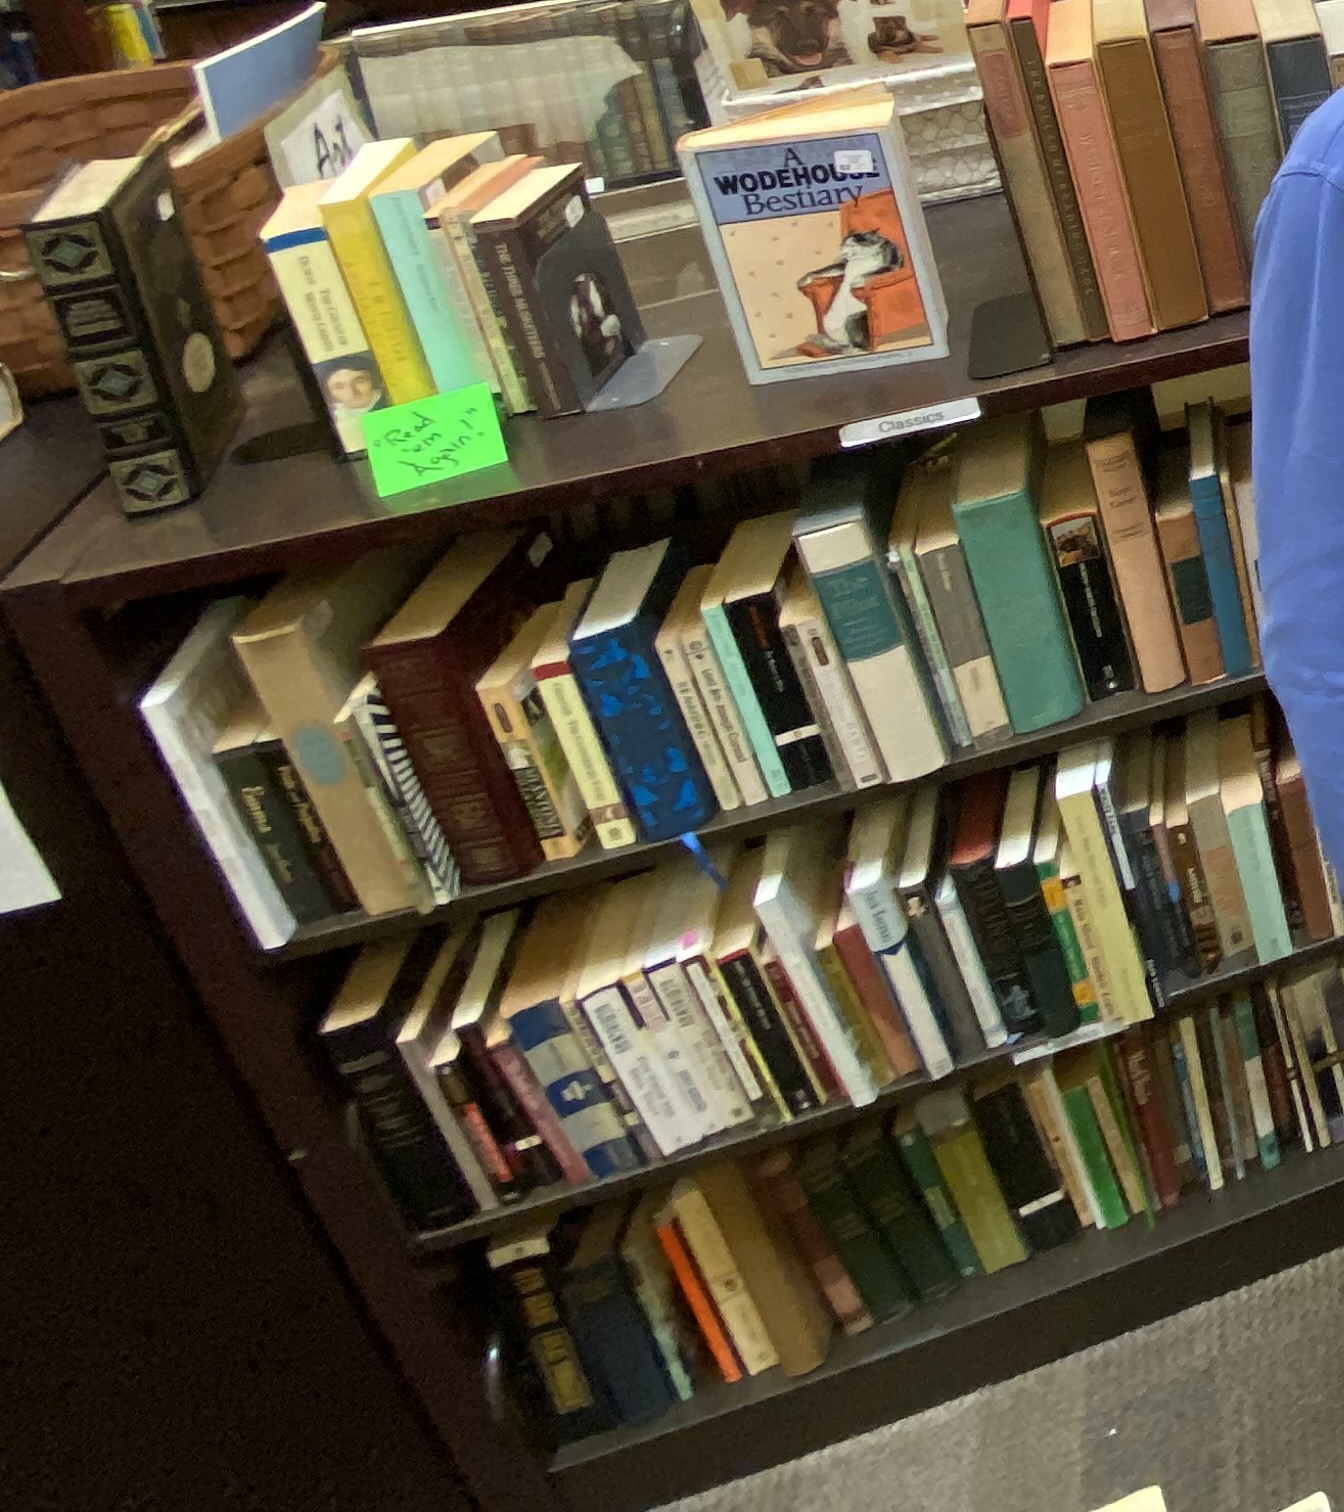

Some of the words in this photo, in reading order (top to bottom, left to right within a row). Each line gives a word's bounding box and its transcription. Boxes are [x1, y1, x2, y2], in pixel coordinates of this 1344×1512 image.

[783, 147, 804, 168] A
[741, 185, 864, 216] Bestiary
[878, 411, 945, 434] Classics
